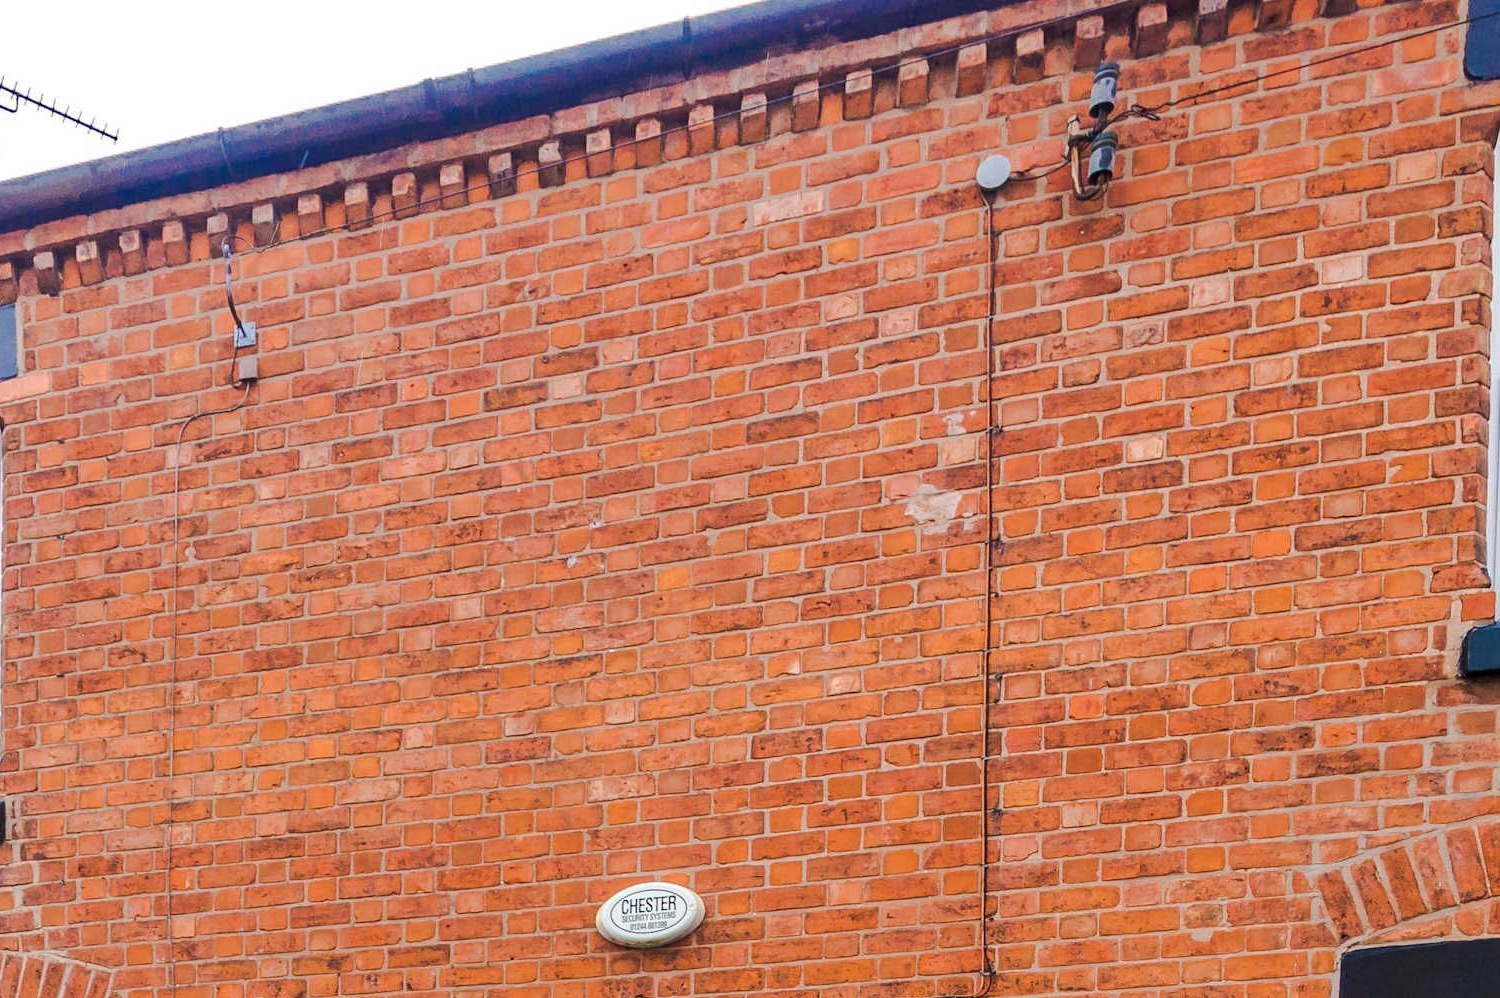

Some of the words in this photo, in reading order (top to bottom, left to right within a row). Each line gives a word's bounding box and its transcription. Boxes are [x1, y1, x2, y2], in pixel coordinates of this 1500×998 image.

[621, 895, 677, 915] CHESTER
[621, 913, 649, 923] SECURITY
[650, 911, 677, 921] SYSTEMS
